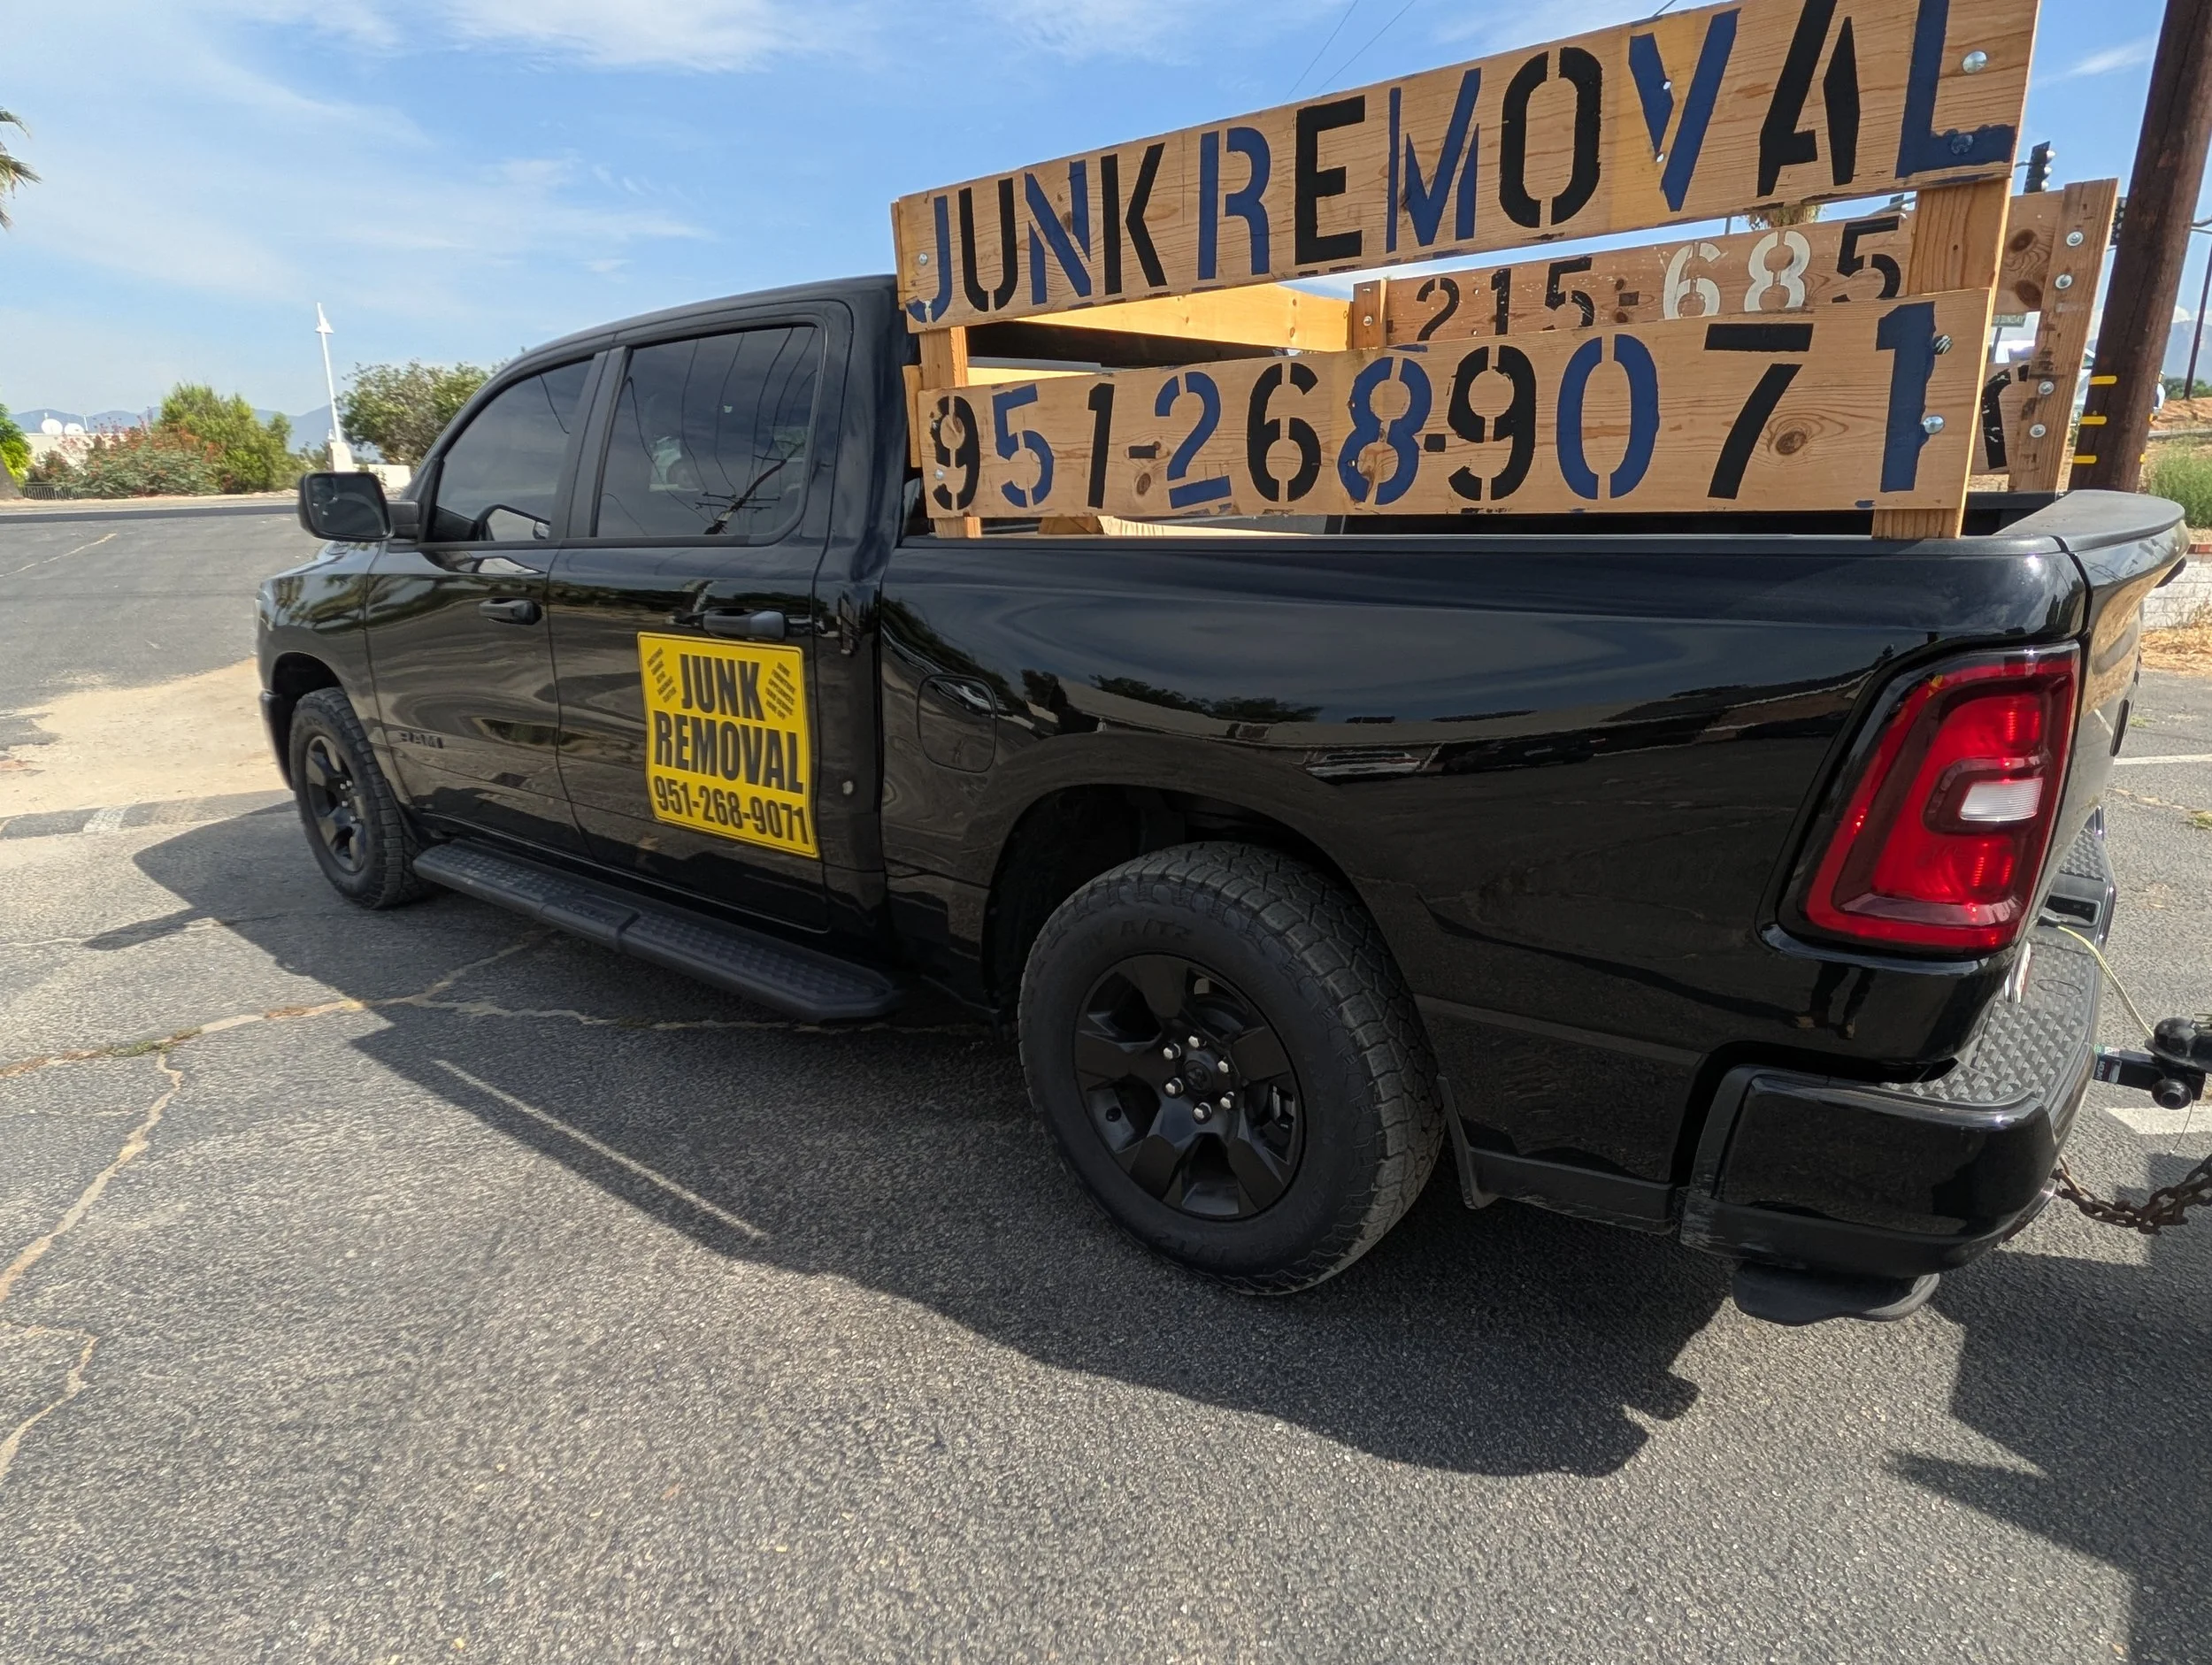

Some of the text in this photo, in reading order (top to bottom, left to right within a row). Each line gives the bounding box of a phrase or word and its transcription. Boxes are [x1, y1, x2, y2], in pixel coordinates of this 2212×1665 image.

[906, 0, 2019, 323] JUNK REMOVAL
[930, 302, 1938, 510] 951-268-9071
[679, 653, 765, 722] JUNK
[653, 710, 804, 794] REMOVAL
[653, 775, 810, 845] 951-268-9071
